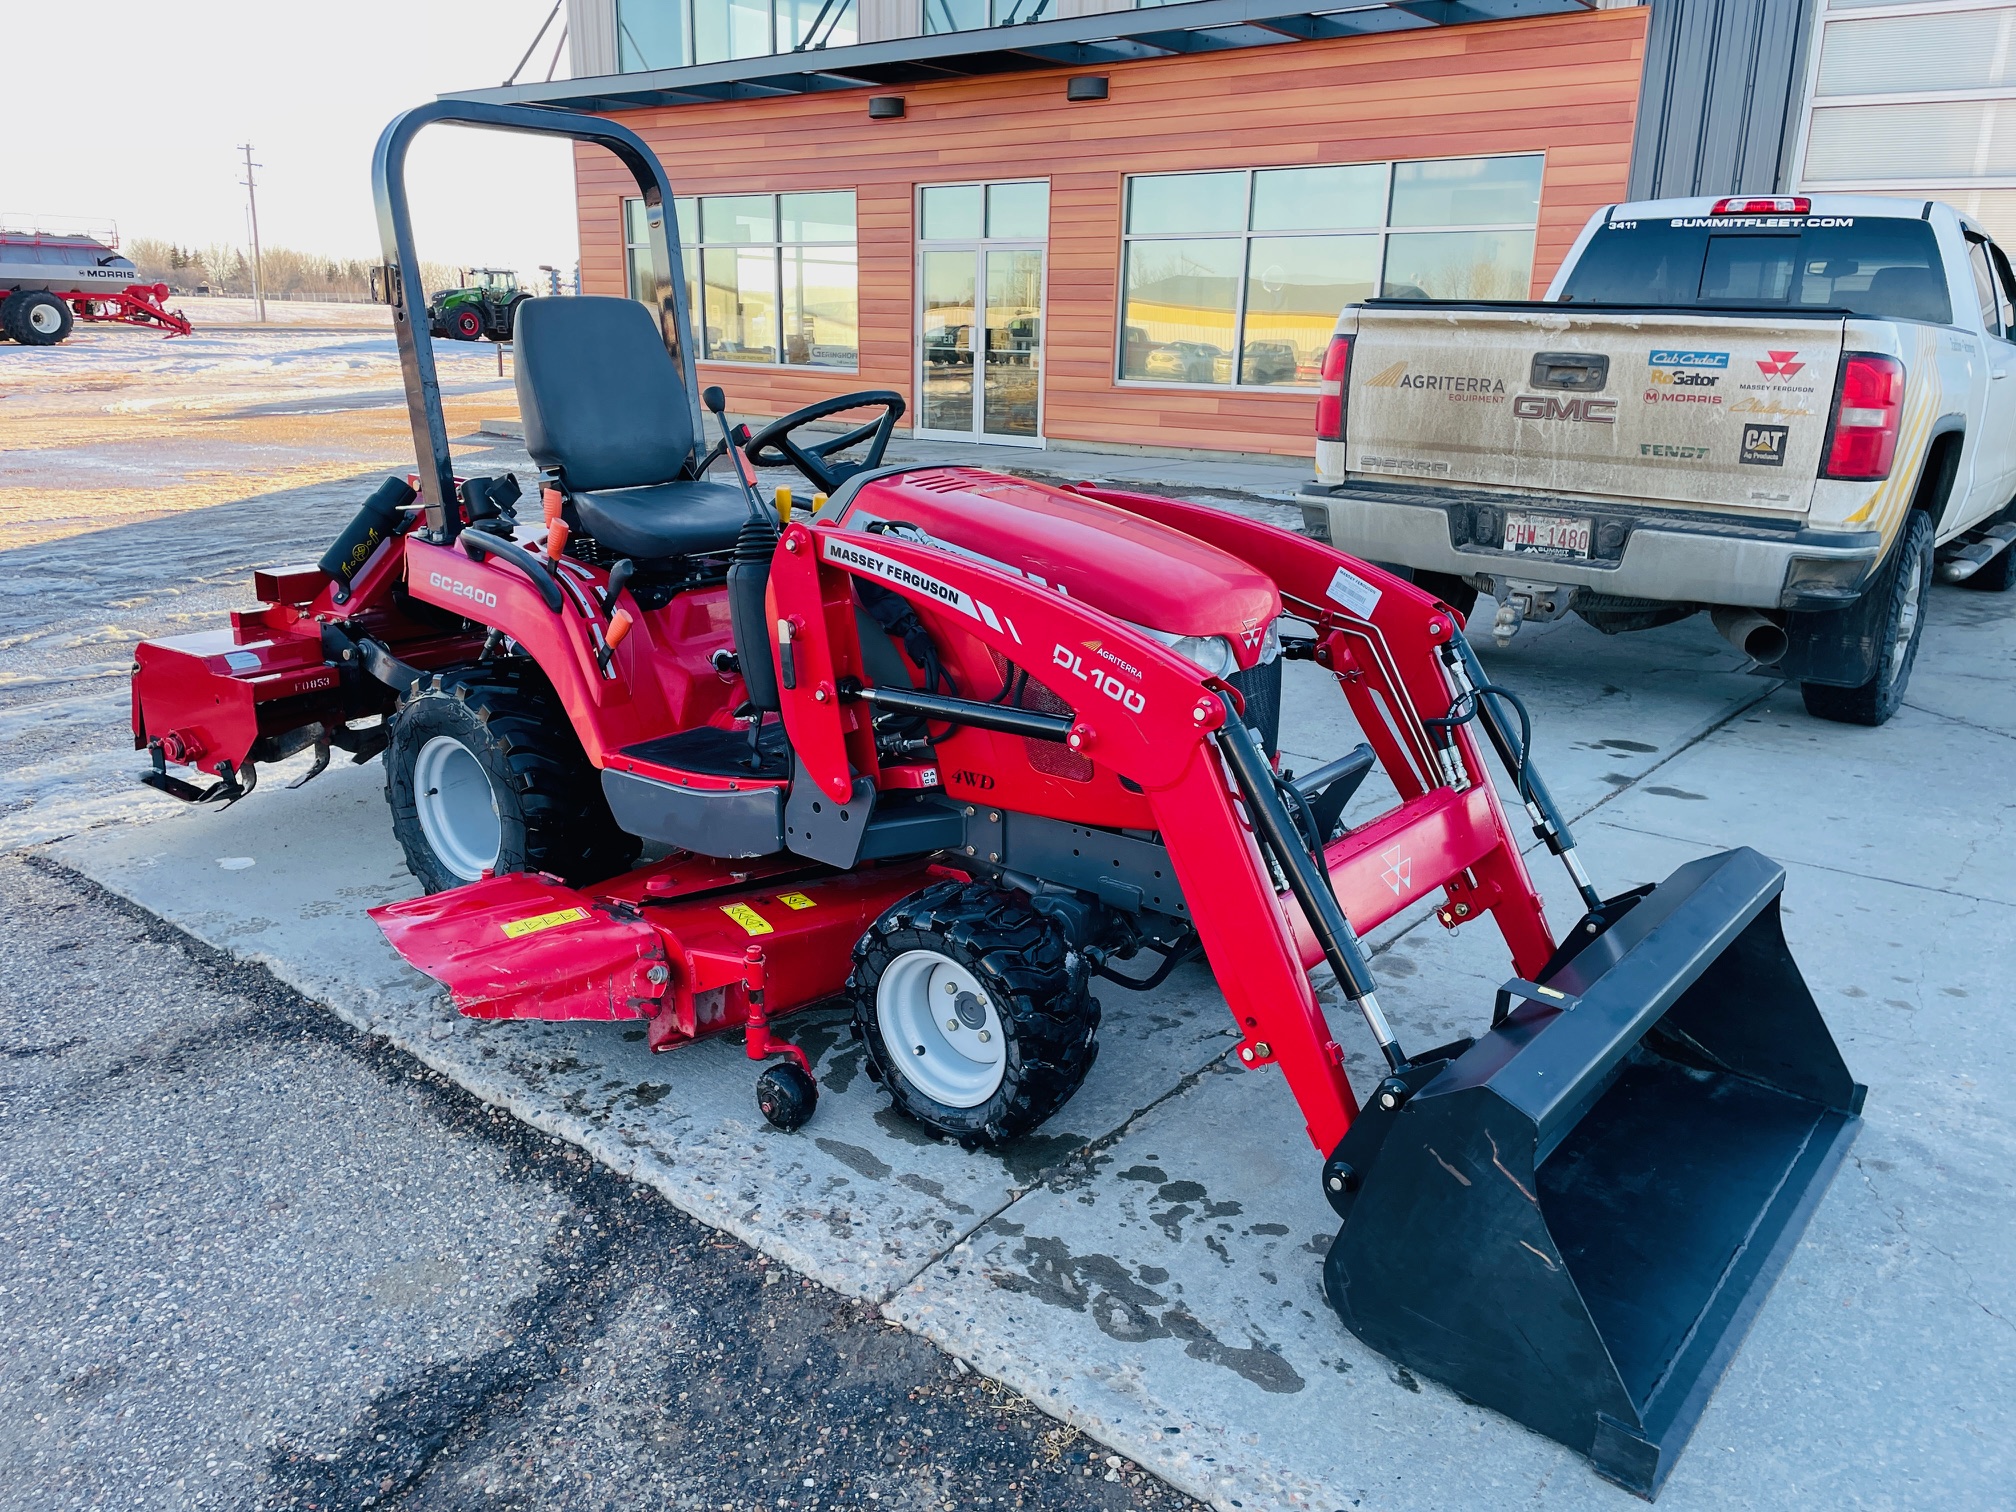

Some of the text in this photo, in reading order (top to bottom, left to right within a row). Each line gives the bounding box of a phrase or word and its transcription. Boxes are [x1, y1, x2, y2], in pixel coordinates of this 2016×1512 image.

[1608, 221, 1637, 230] 3411
[1670, 218, 1853, 228] SUMMITFLEET.COM
[87, 270, 134, 278] MORRIS
[1652, 353, 1725, 366] Cub Cadet
[1400, 374, 1505, 393] AGRITERRA
[1651, 370, 1719, 386] RoGator
[1773, 385, 1815, 393] FERGUSON
[1449, 393, 1505, 404] EQUIPMENT
[1661, 393, 1722, 404] MORRIS
[1513, 395, 1618, 424] GMC
[1745, 430, 1783, 452] CAT
[1640, 444, 1710, 459] FENDT
[1360, 455, 1449, 473] SIERRA
[829, 545, 960, 605] MASSEY FERGUSON
[429, 572, 497, 608] GC2400
[1096, 647, 1143, 680] AGRITERRA
[1053, 643, 1146, 714] DL100
[951, 768, 995, 790] 4WD
